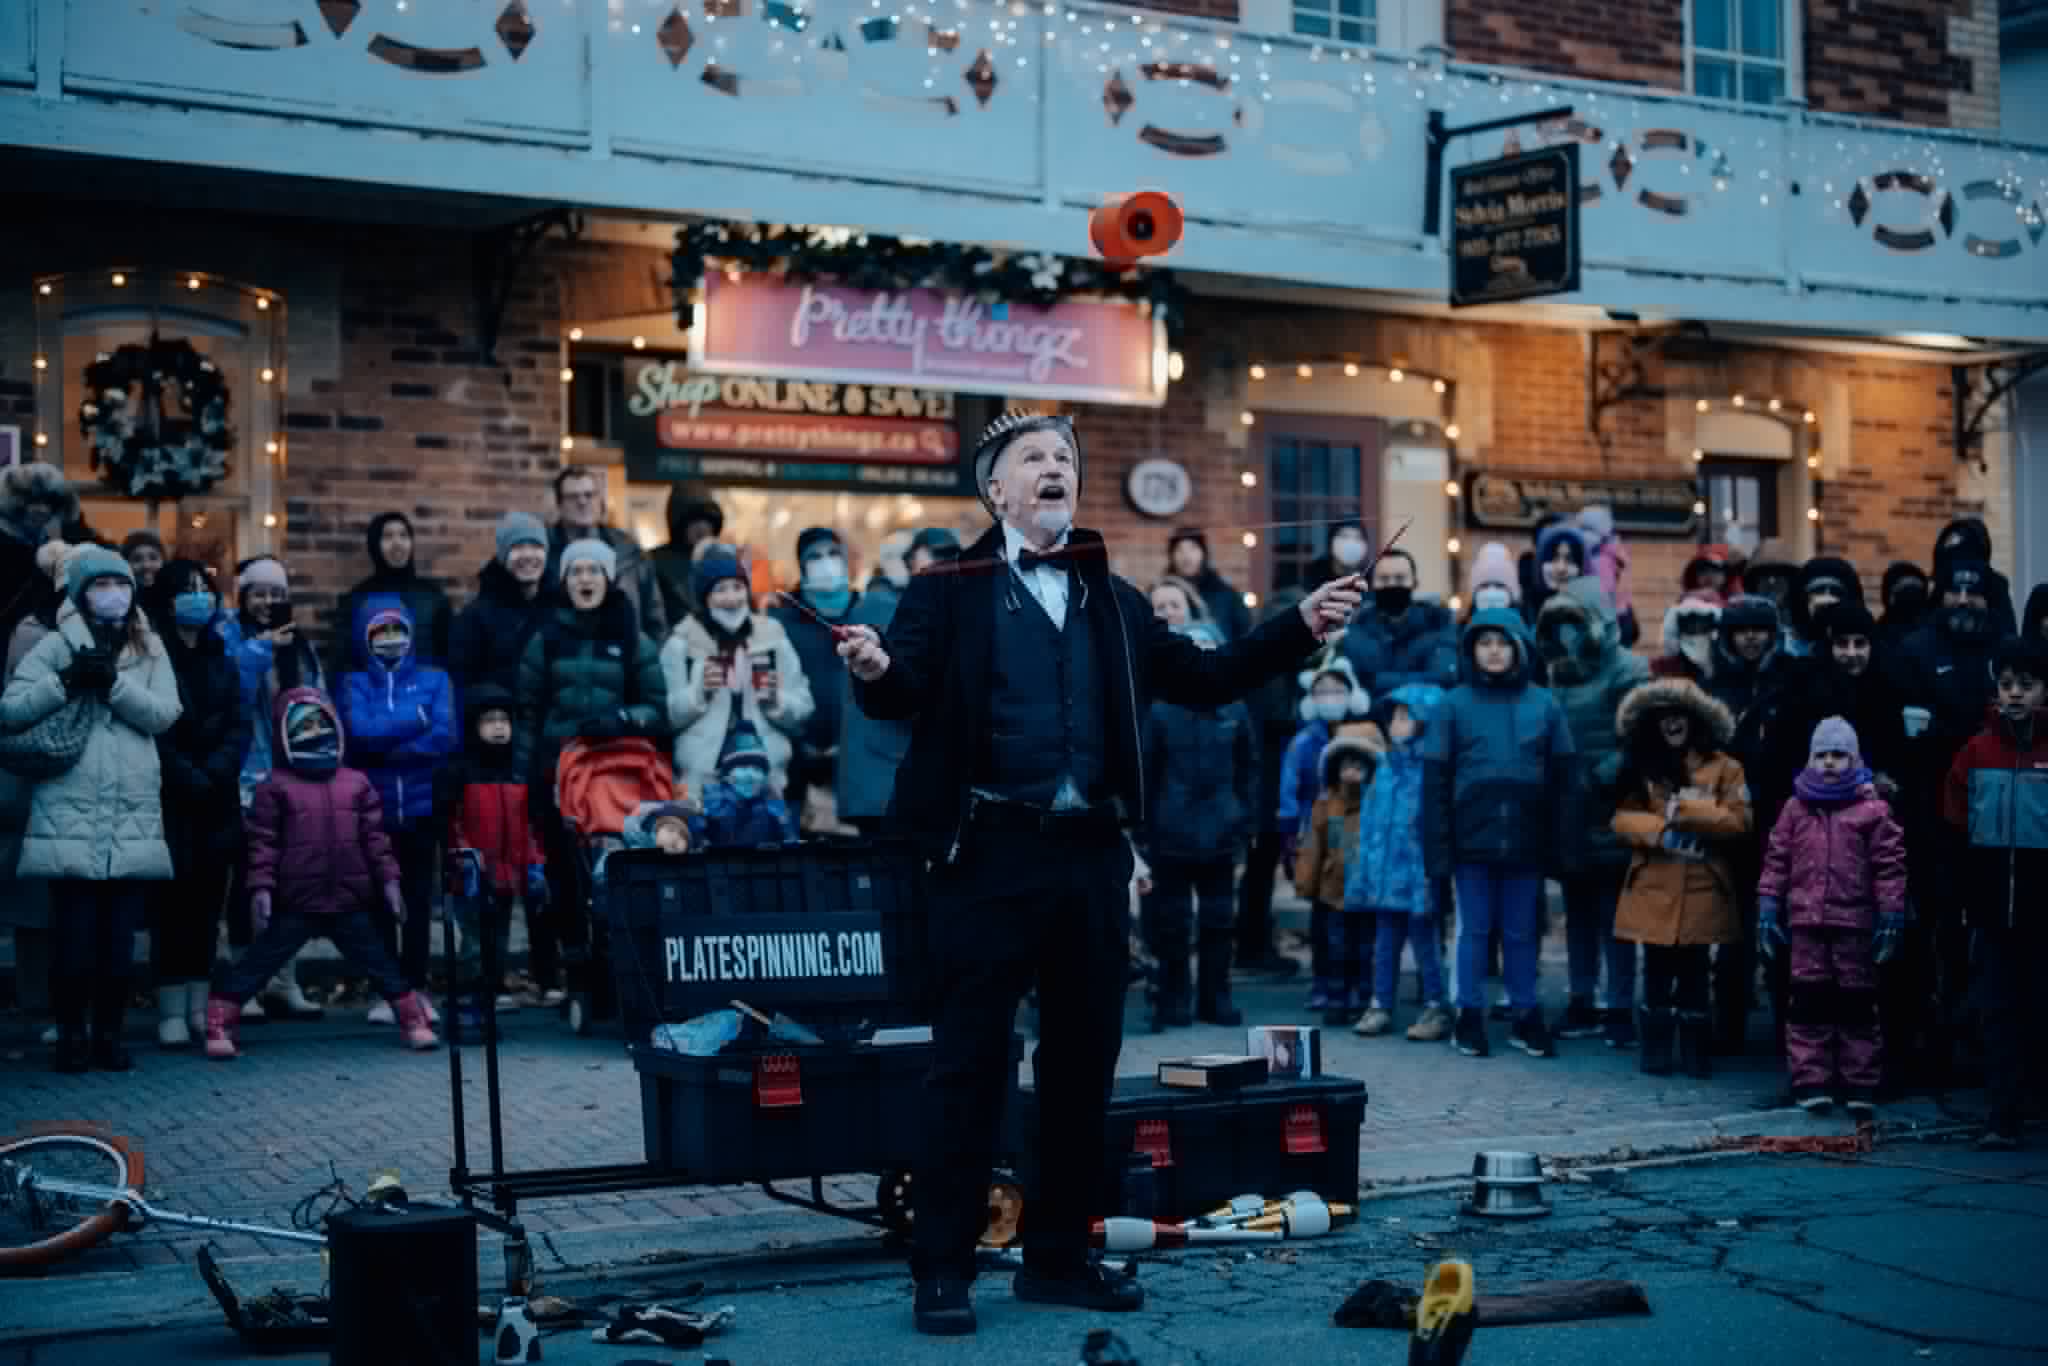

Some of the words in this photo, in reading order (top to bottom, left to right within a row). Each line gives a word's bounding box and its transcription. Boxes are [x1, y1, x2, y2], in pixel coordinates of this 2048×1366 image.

[790, 285, 927, 375] Pretty
[628, 361, 720, 418] Shop
[721, 377, 839, 413] ONLINE
[664, 932, 884, 983] PLATESPINNING.COM
